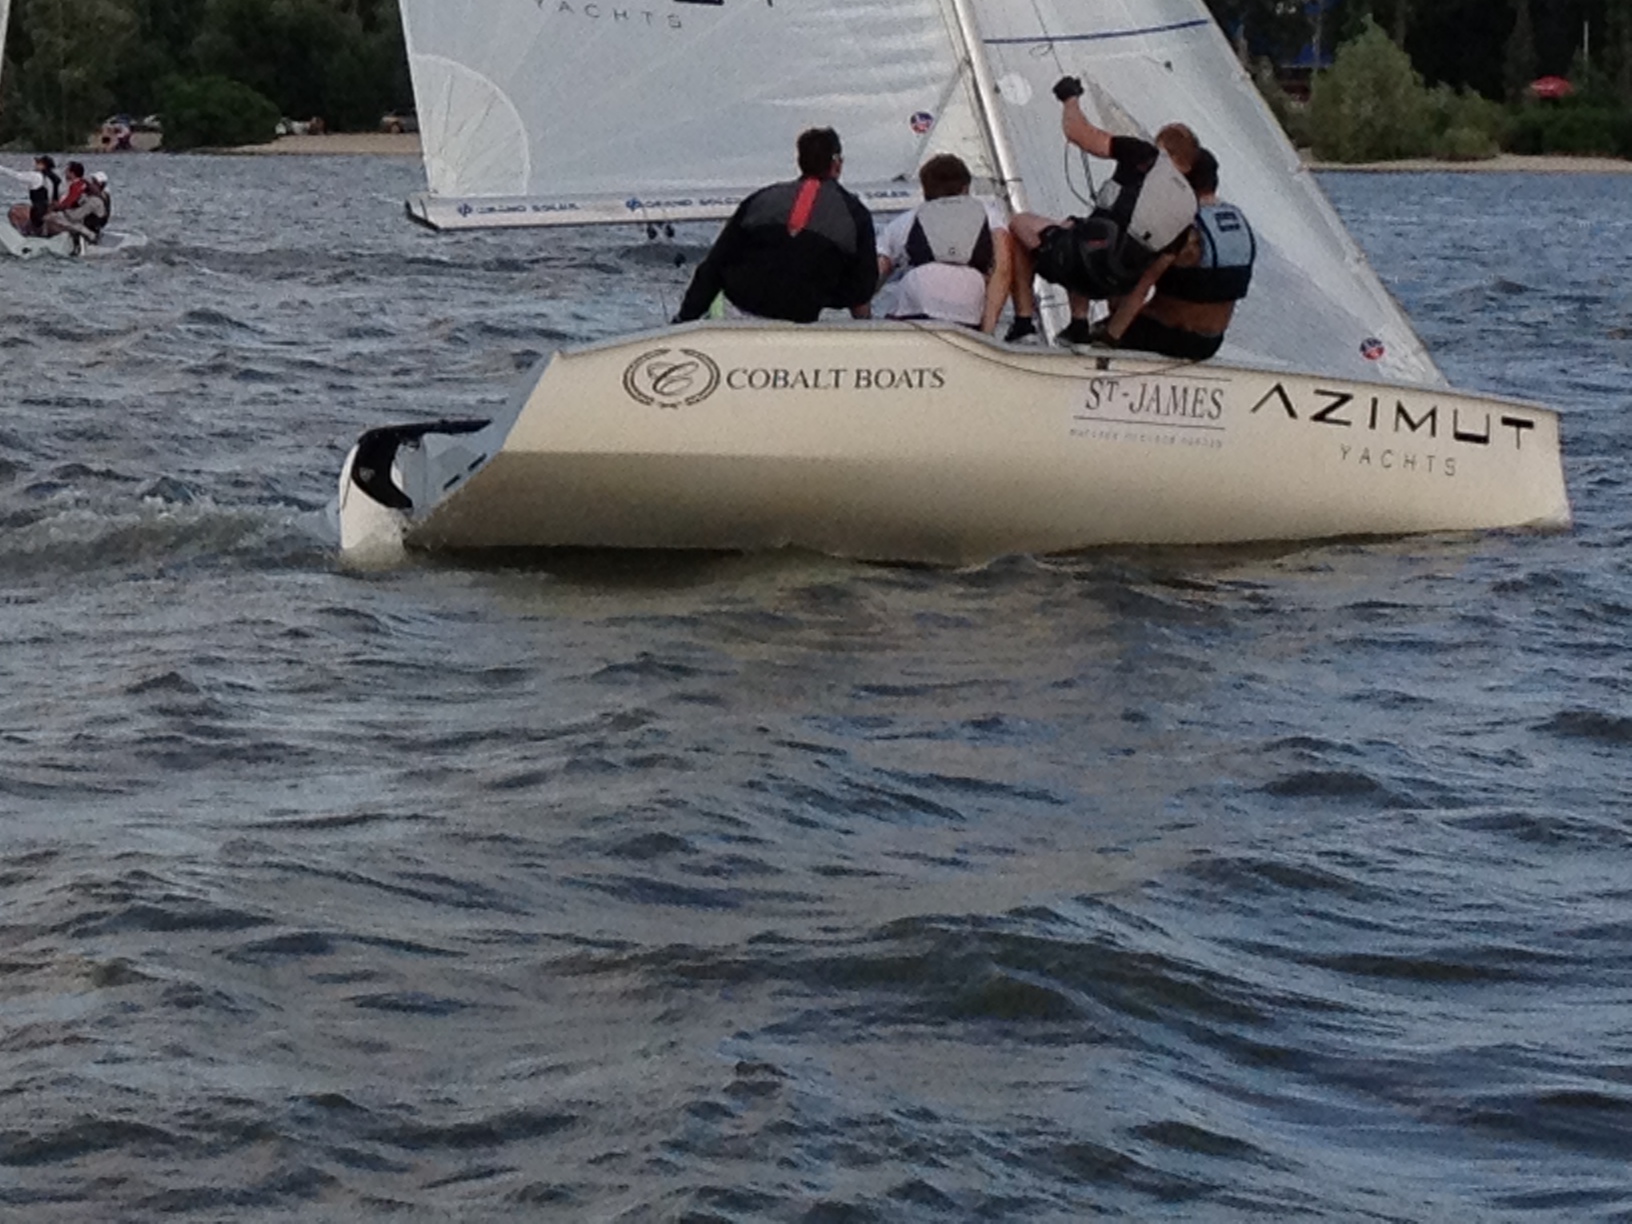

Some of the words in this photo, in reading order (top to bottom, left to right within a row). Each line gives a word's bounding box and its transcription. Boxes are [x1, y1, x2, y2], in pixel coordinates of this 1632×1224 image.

[725, 368, 847, 390] COBALT
[854, 367, 946, 390] BOATS
[1251, 382, 1535, 450] AZIMUT
[1339, 443, 1457, 477] YACHTS
